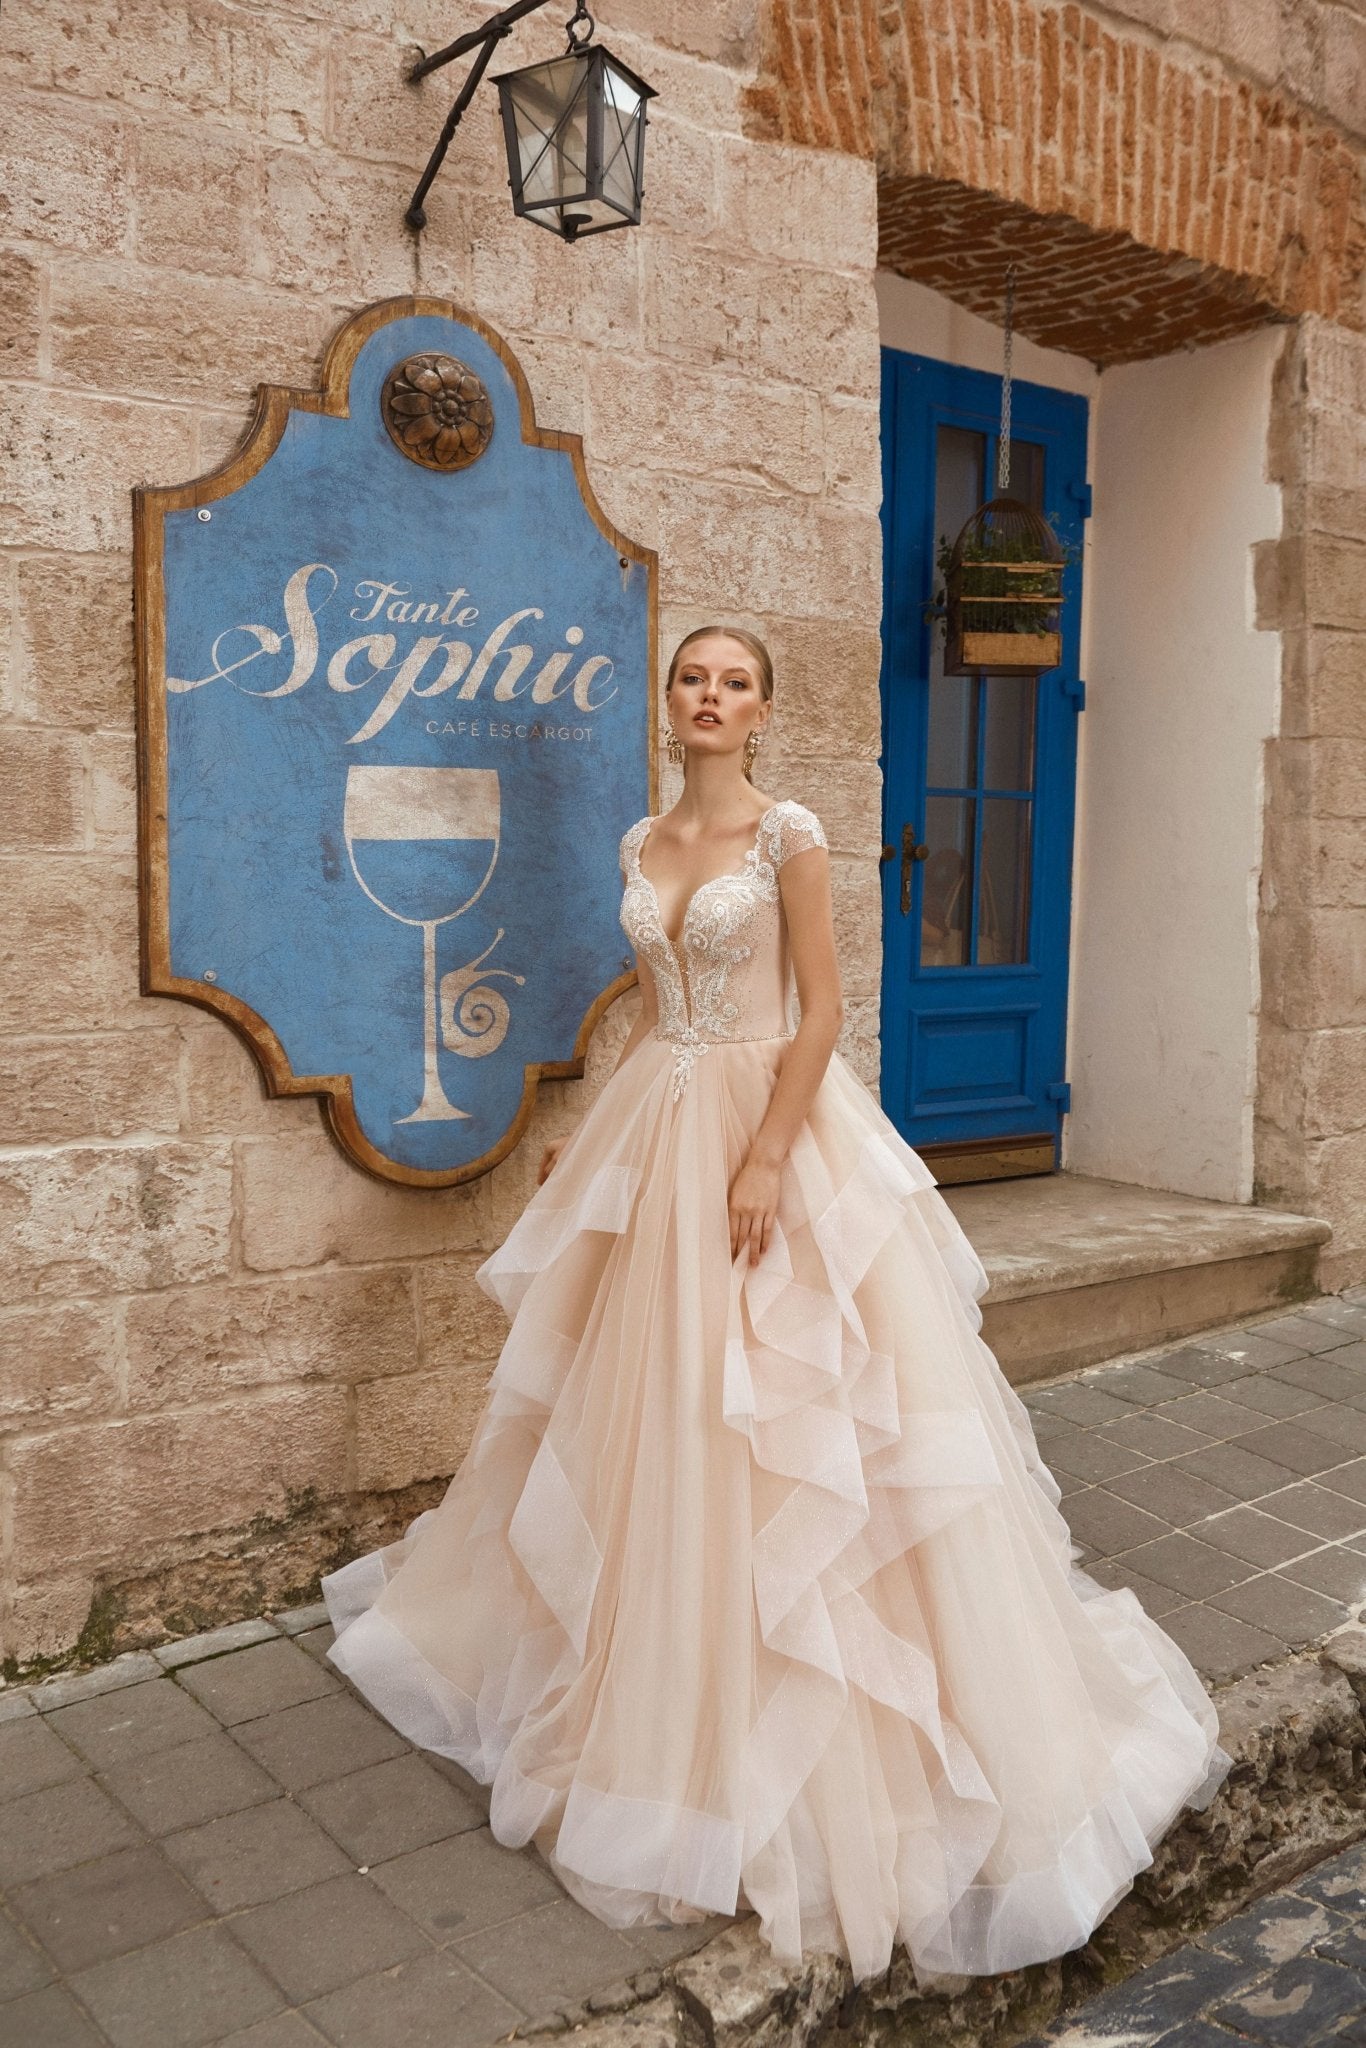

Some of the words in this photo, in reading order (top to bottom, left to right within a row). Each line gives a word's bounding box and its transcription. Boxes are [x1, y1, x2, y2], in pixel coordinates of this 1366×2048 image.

[349, 580, 480, 628] Tante
[166, 563, 619, 745] Sophie
[489, 723, 593, 742] ESCARGOT
